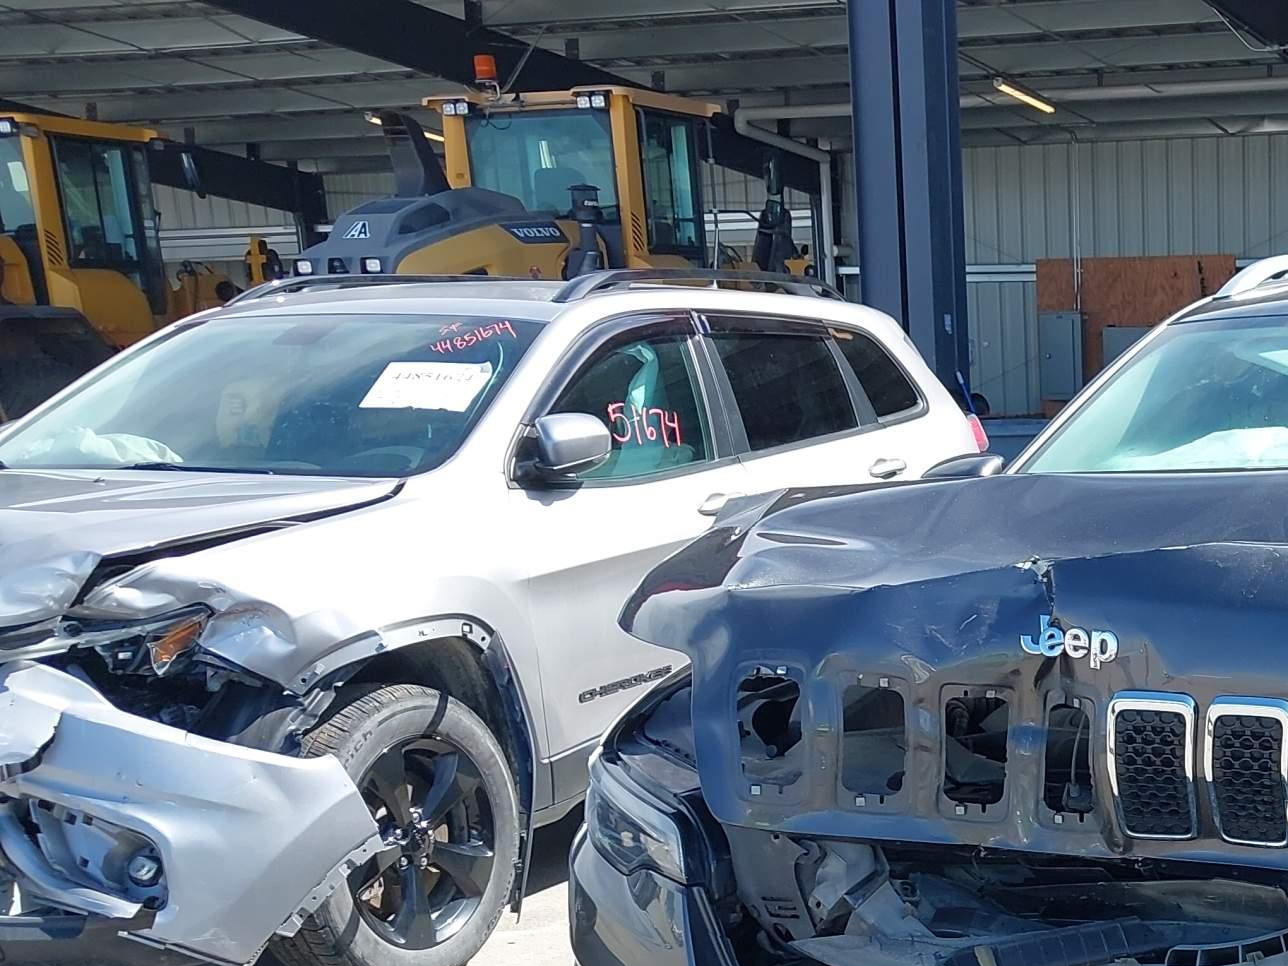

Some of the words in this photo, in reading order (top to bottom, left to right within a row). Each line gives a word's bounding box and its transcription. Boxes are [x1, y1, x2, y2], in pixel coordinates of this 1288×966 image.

[511, 227, 560, 237] VOLVO
[430, 320, 517, 354] 44851674
[607, 403, 681, 448] 51674
[1020, 615, 1119, 670] Jeep
